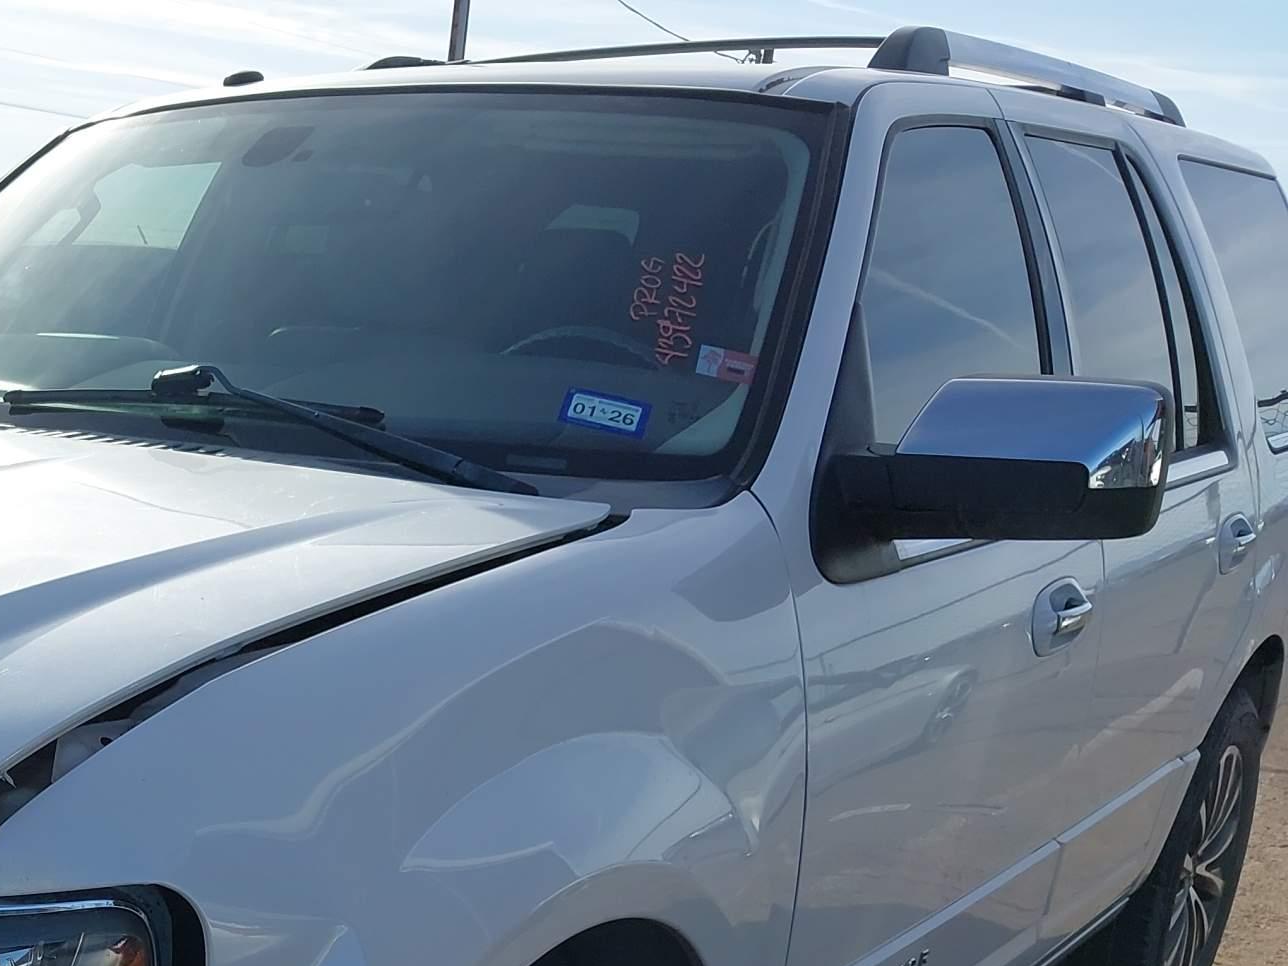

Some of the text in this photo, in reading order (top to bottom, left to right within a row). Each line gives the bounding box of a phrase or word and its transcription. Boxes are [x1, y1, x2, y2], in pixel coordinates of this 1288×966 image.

[630, 256, 665, 320] PROG
[572, 401, 636, 426] 01 26
